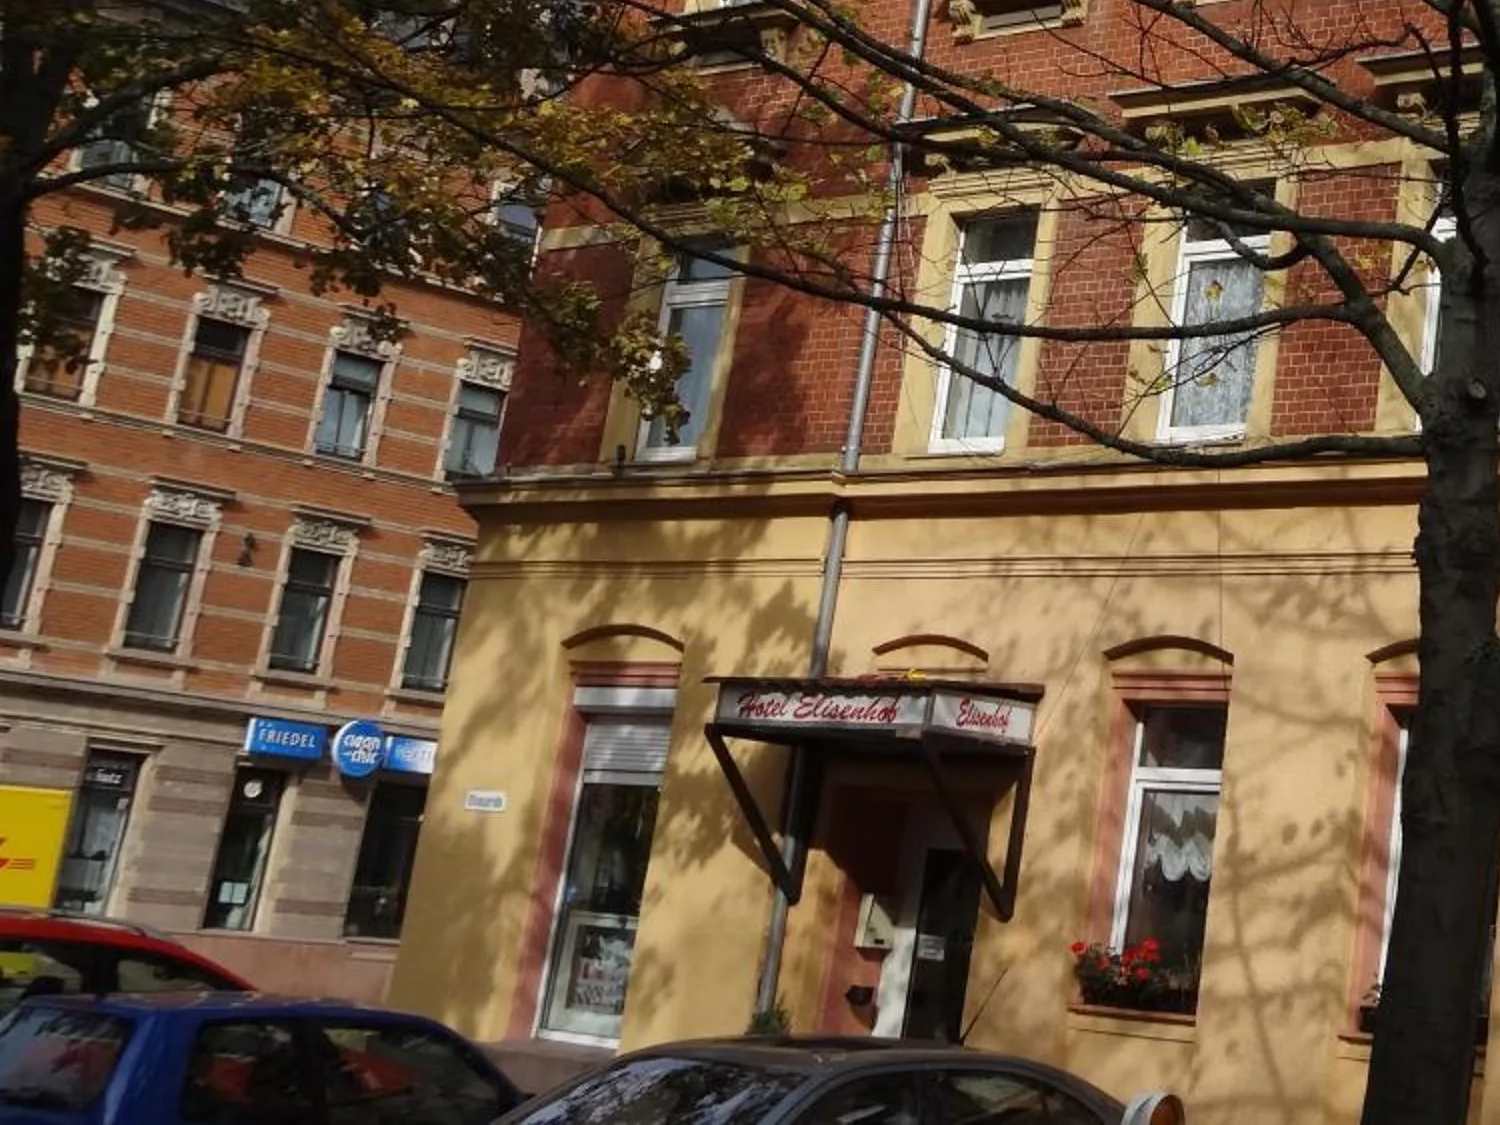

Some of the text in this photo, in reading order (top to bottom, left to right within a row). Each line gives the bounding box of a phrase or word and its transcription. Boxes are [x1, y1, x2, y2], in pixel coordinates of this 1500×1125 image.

[739, 691, 899, 724] Hotel Elisenhof
[956, 698, 1011, 734] Elisenhof
[259, 728, 316, 748] FRIEDEL
